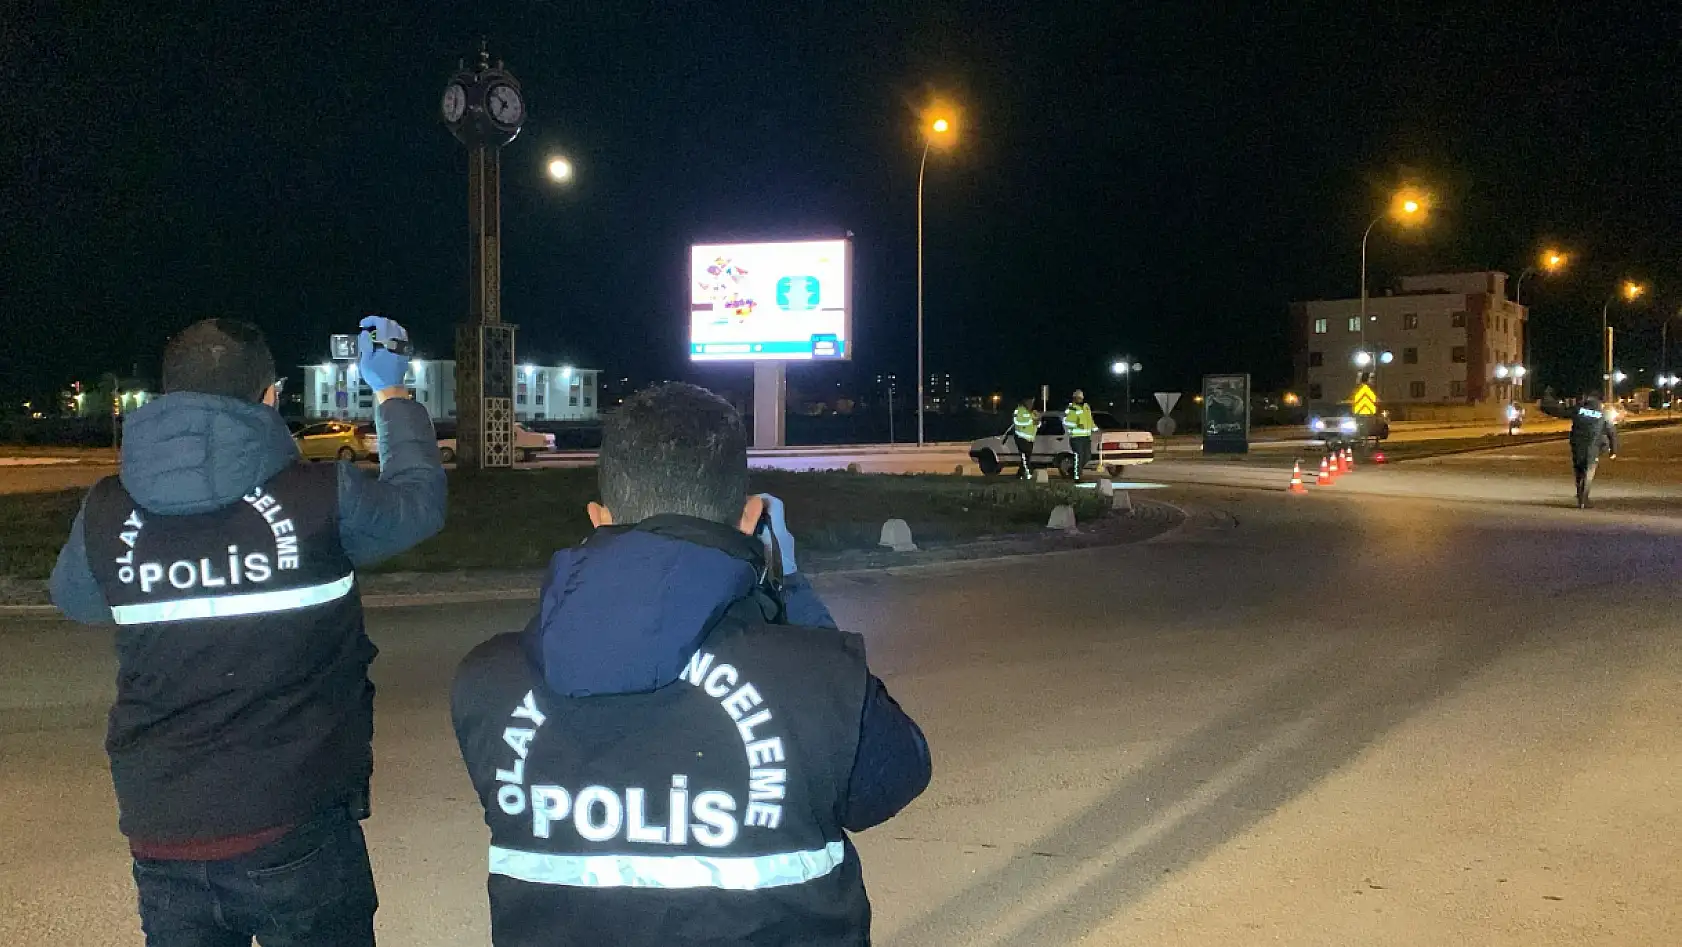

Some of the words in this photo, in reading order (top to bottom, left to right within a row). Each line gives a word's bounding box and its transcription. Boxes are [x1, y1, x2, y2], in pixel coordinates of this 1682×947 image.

[116, 510, 143, 584] OLAY
[140, 544, 271, 592] POLİS
[496, 689, 546, 815] OLAY
[679, 648, 786, 829] NCELEME
[531, 774, 738, 847] POLİS
